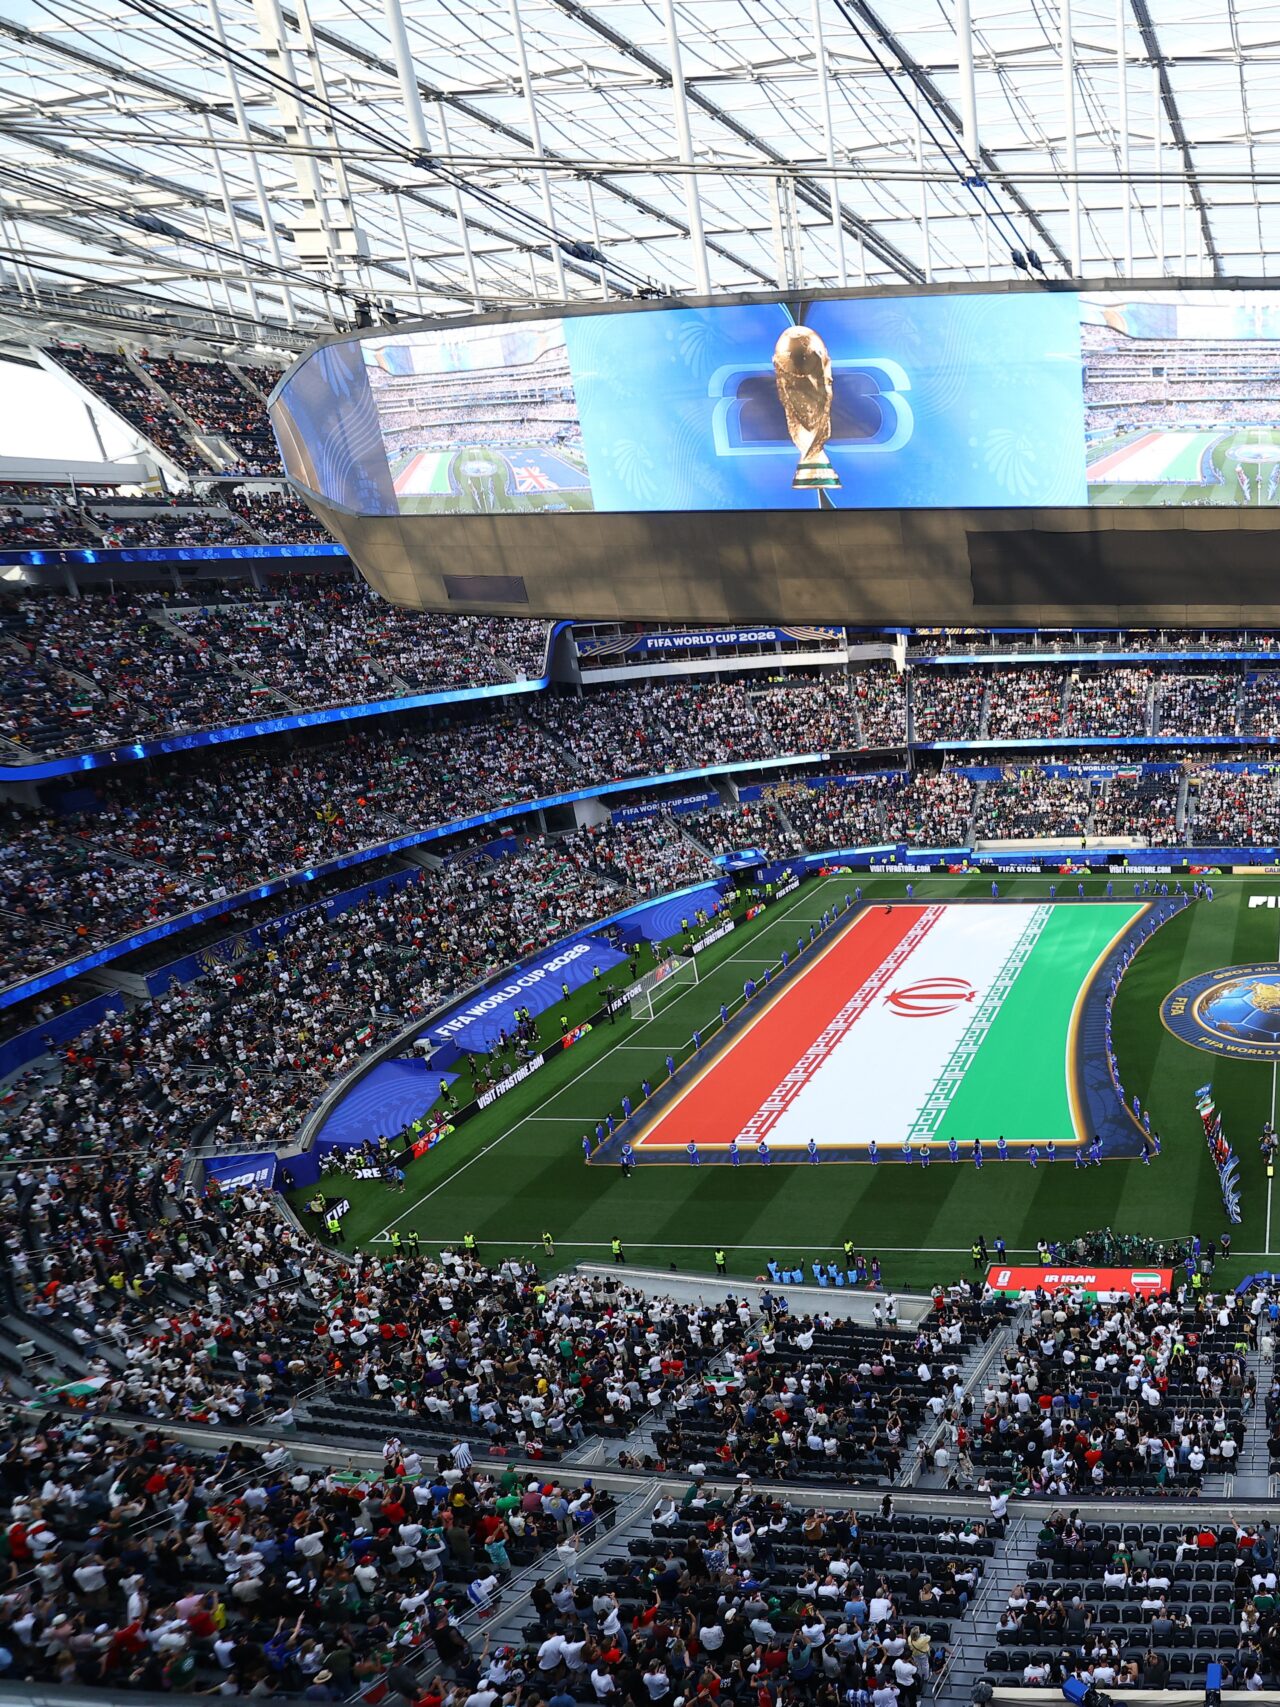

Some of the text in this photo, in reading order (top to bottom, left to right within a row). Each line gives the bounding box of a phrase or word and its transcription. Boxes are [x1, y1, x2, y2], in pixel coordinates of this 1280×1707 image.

[647, 631, 776, 647] FIFA WORLD CUP 2026
[623, 808, 639, 816] FIFA
[640, 802, 667, 813] WORD
[683, 794, 708, 804] 2026
[434, 943, 591, 1037] FIFA WORLD CUP 2026
[622, 984, 642, 1003] STORE
[1170, 997, 1188, 1016] FIFA
[1198, 1036, 1224, 1050] FIFA
[1226, 1044, 1274, 1056] WORLD
[477, 1054, 545, 1110] VISIT FIFASTORE.COM
[1044, 1275, 1096, 1283] IR IRAN
